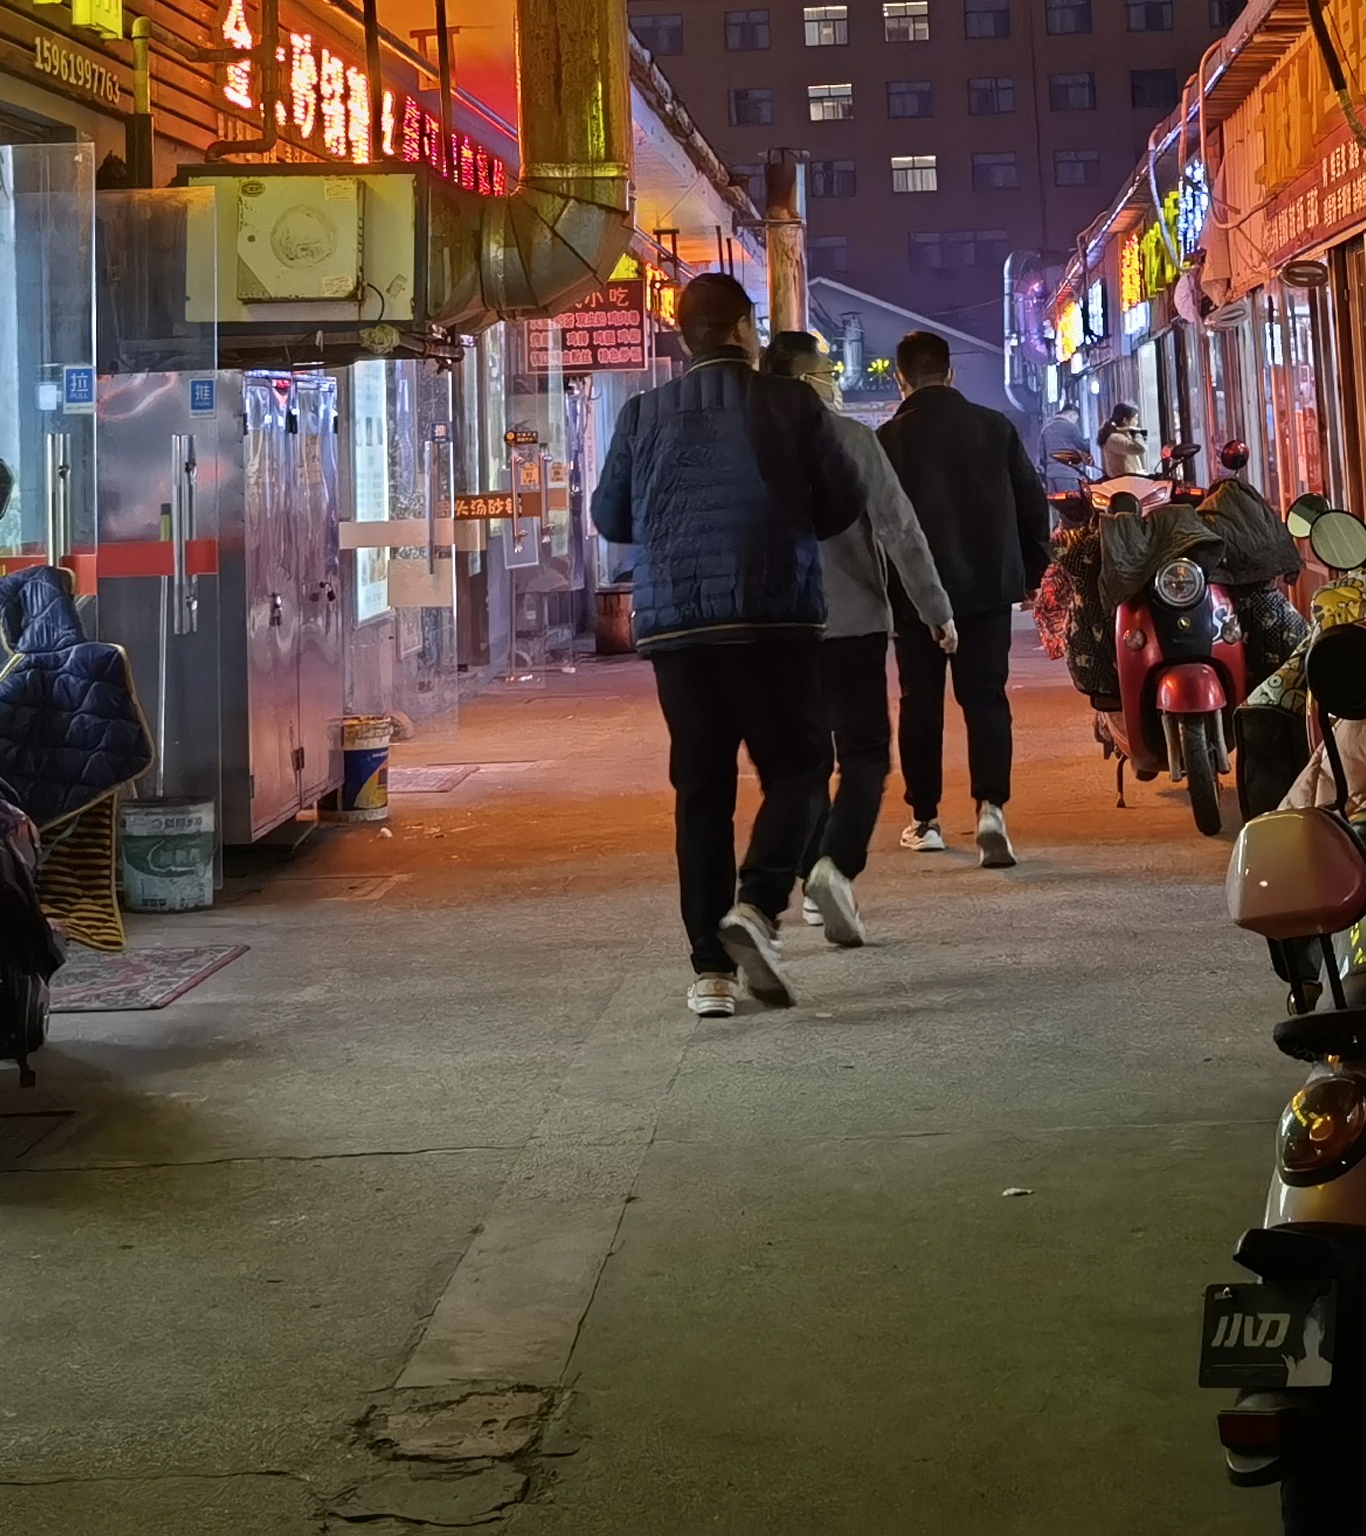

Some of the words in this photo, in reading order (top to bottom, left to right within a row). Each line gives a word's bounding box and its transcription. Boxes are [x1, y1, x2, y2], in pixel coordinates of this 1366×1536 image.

[34, 36, 122, 104] 15961997763
[575, 287, 631, 309] 小吃
[69, 371, 89, 392] 拉
